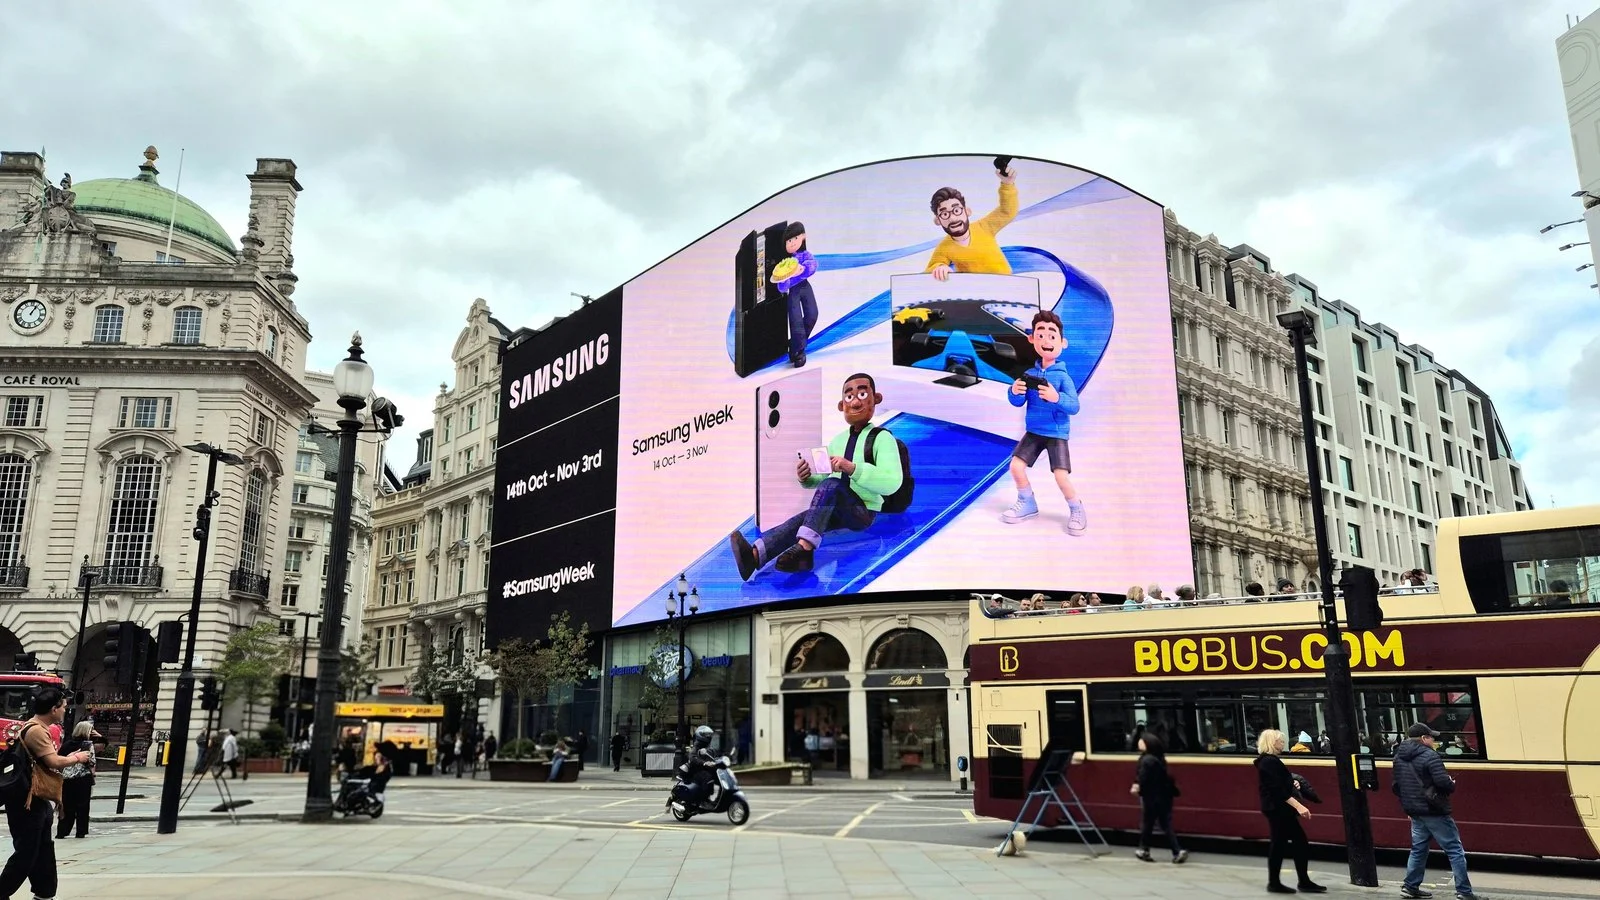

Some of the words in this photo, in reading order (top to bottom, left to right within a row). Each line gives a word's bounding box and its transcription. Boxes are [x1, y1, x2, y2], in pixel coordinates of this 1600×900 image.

[4, 374, 36, 385] CAFÉ
[41, 376, 80, 385] ROYAL
[509, 333, 609, 409] SAMSUNG
[632, 422, 690, 456] Samsung
[694, 404, 734, 433] Week
[653, 460, 660, 471] 14
[662, 454, 676, 468] Oct
[686, 448, 691, 459] 3
[692, 444, 708, 457] Nov
[506, 479, 527, 500] 14th
[528, 470, 548, 492] Oct
[557, 460, 580, 482] Nov
[581, 449, 602, 473] 3rd
[502, 561, 596, 598] #SamsungWeek
[702, 655, 730, 668] beauty
[888, 675, 916, 686] Lindt
